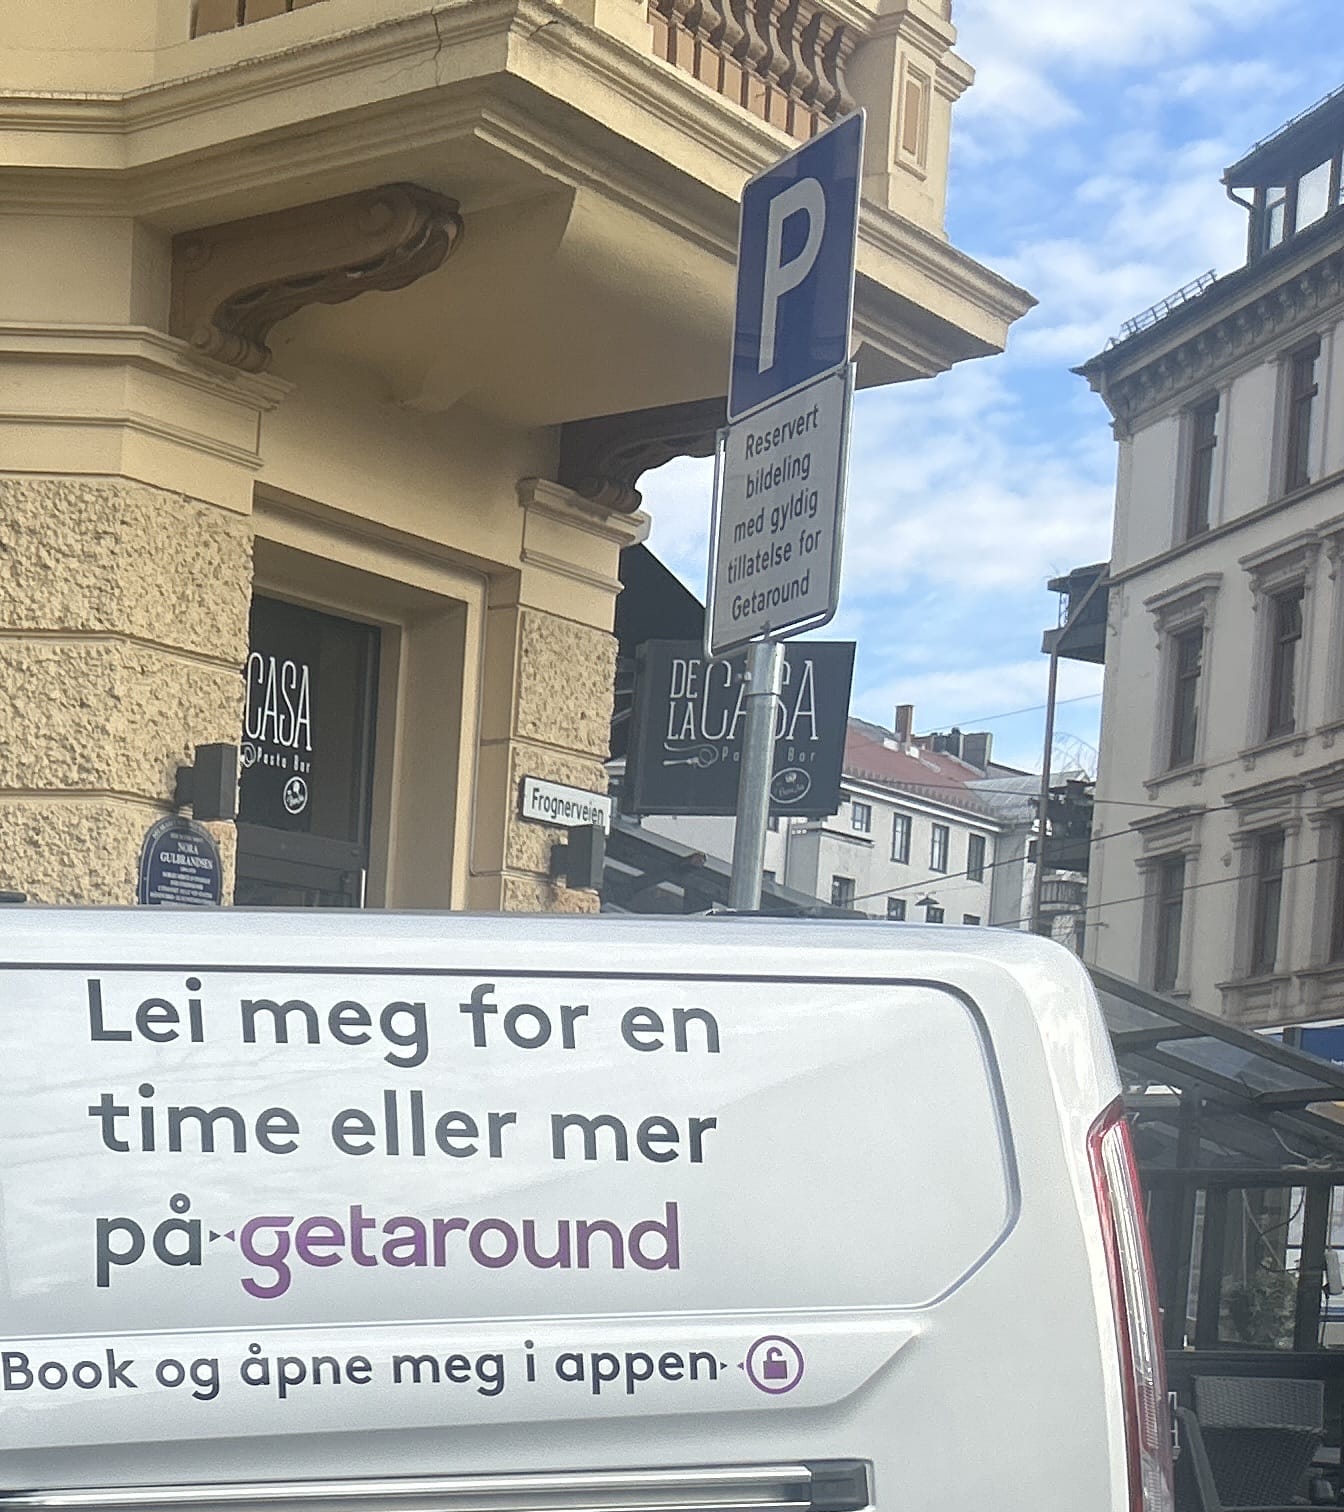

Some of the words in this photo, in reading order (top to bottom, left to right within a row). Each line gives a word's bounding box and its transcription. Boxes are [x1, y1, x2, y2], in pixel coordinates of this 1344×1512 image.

[756, 175, 827, 376] P
[745, 404, 819, 459] Reservert
[746, 452, 811, 499] bildeling
[734, 507, 764, 543] med
[770, 488, 819, 534] gyldig
[728, 541, 792, 584] tillatelse
[799, 529, 821, 556] for
[732, 568, 811, 621] Getaround
[245, 652, 312, 751] CASA
[670, 659, 700, 698] DE
[667, 701, 696, 740] LA
[531, 787, 604, 826] Frognerveien
[88, 976, 204, 1043] Lei
[241, 996, 430, 1067] meg
[460, 983, 590, 1050] for
[620, 1000, 722, 1055] en
[88, 1082, 301, 1154] time
[330, 1088, 518, 1160] eller
[550, 1110, 718, 1164] mer
[95, 1193, 204, 1288] på
[239, 1202, 681, 1300] getaround
[0, 1350, 136, 1391] Book
[154, 1357, 221, 1400] og
[240, 1342, 375, 1400] åpne
[392, 1352, 505, 1396] meg
[524, 1339, 536, 1382] i
[554, 1348, 720, 1395] appen
